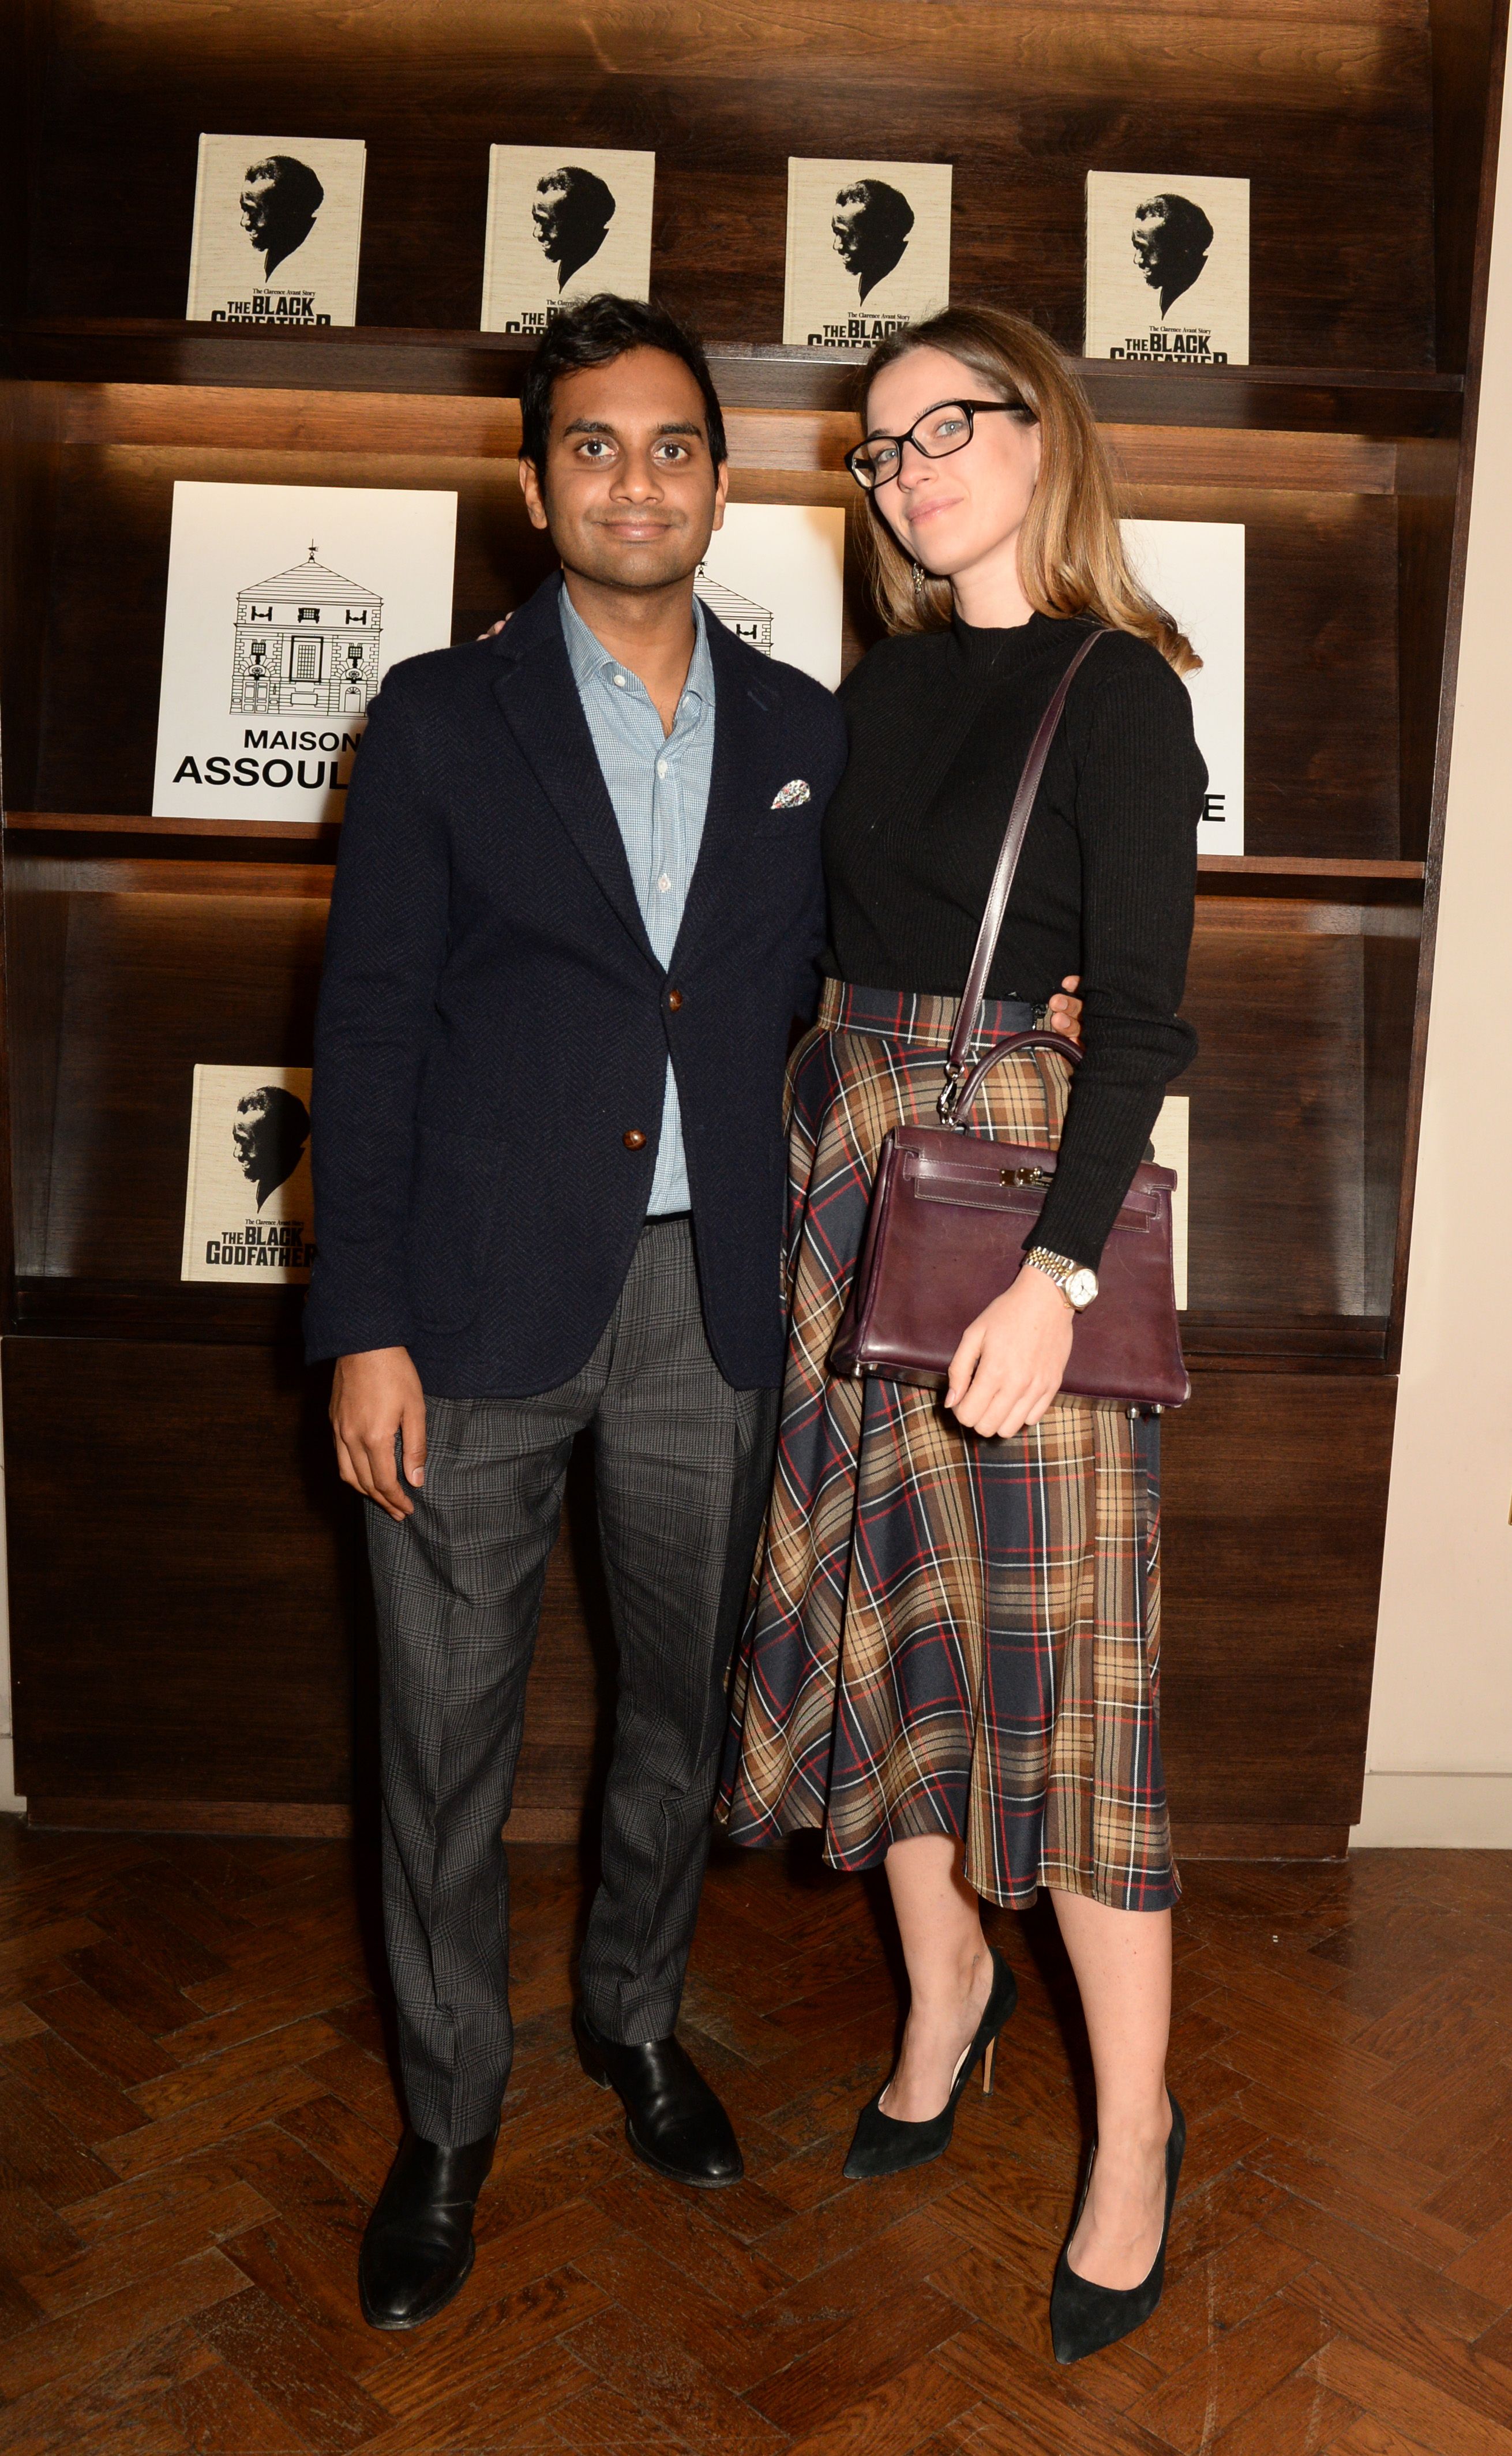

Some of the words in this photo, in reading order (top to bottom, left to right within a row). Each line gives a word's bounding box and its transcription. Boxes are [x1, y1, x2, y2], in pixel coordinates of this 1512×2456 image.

[227, 301, 251, 314] THE
[252, 295, 316, 316] BLACK
[521, 312, 545, 325] THE
[823, 325, 846, 338] THE
[1125, 339, 1149, 351] THE
[1149, 333, 1211, 354] BLACK
[243, 729, 361, 752] MAISON
[222, 1232, 244, 1244] THE
[245, 1226, 305, 1246] BLACK
[206, 1241, 317, 1267] GODFATHER
